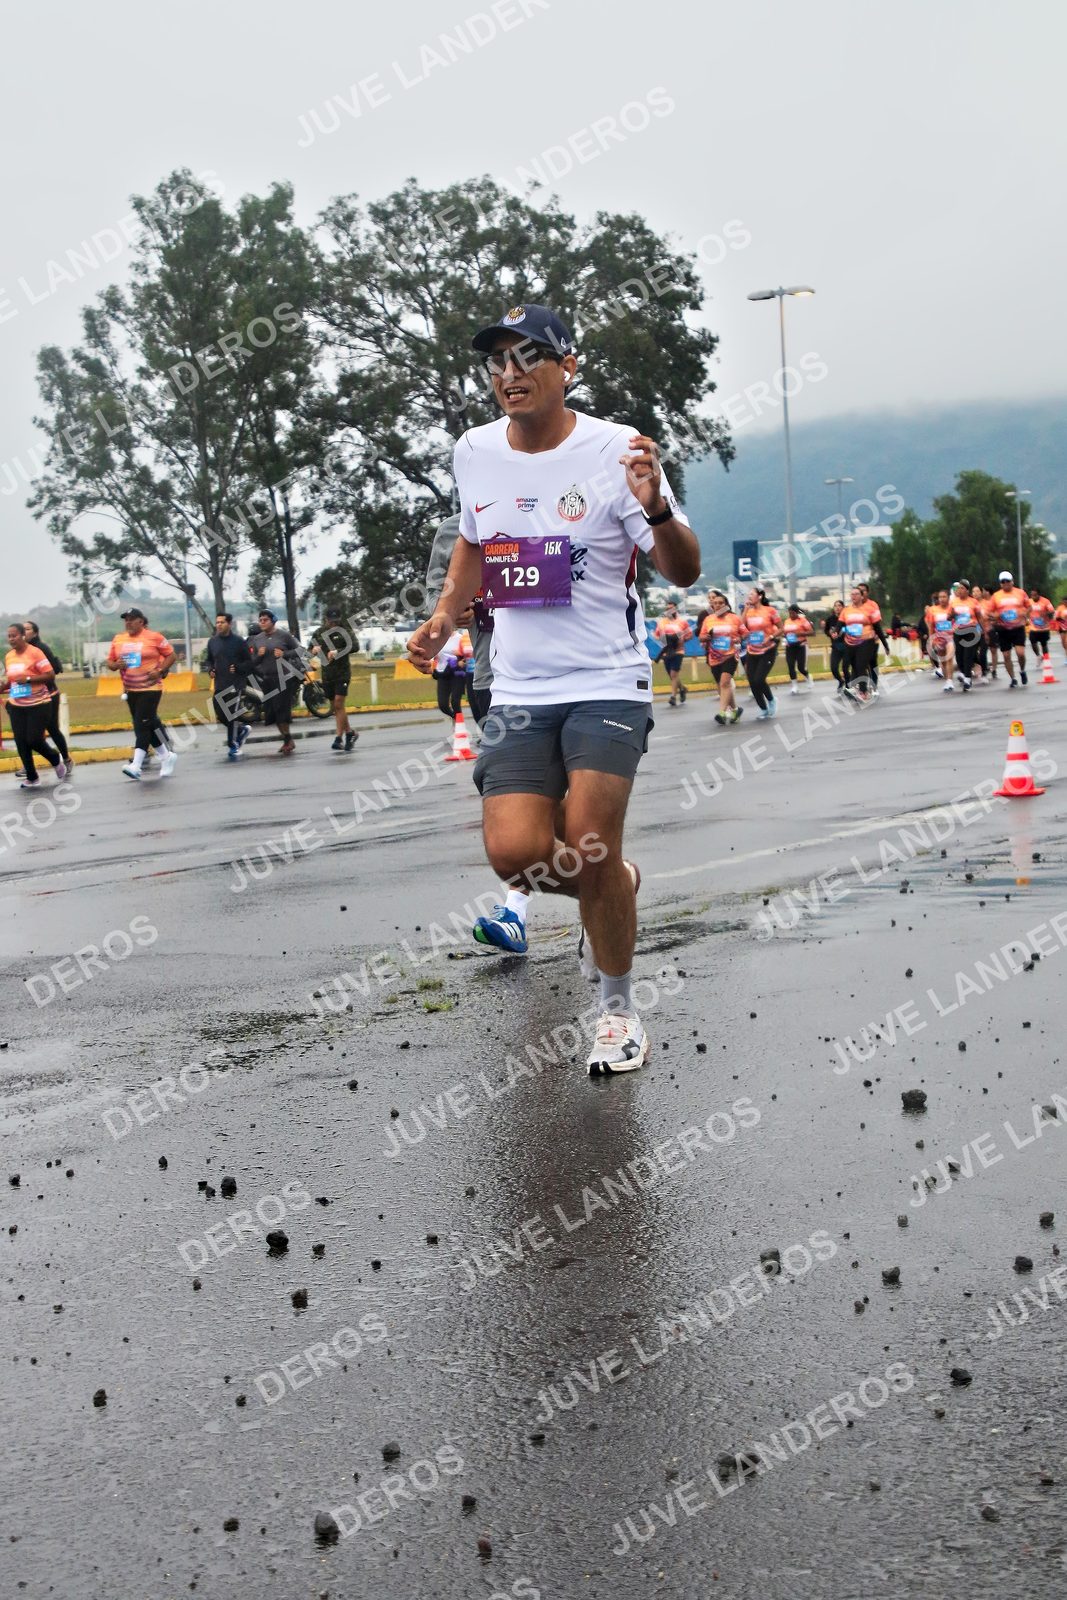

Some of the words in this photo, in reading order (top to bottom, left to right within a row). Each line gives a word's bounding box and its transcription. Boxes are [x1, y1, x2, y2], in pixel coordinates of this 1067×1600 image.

[485, 543, 520, 556] CARRERA
[544, 541, 562, 556] 15K
[738, 558, 752, 576] E
[500, 566, 540, 587] 129
